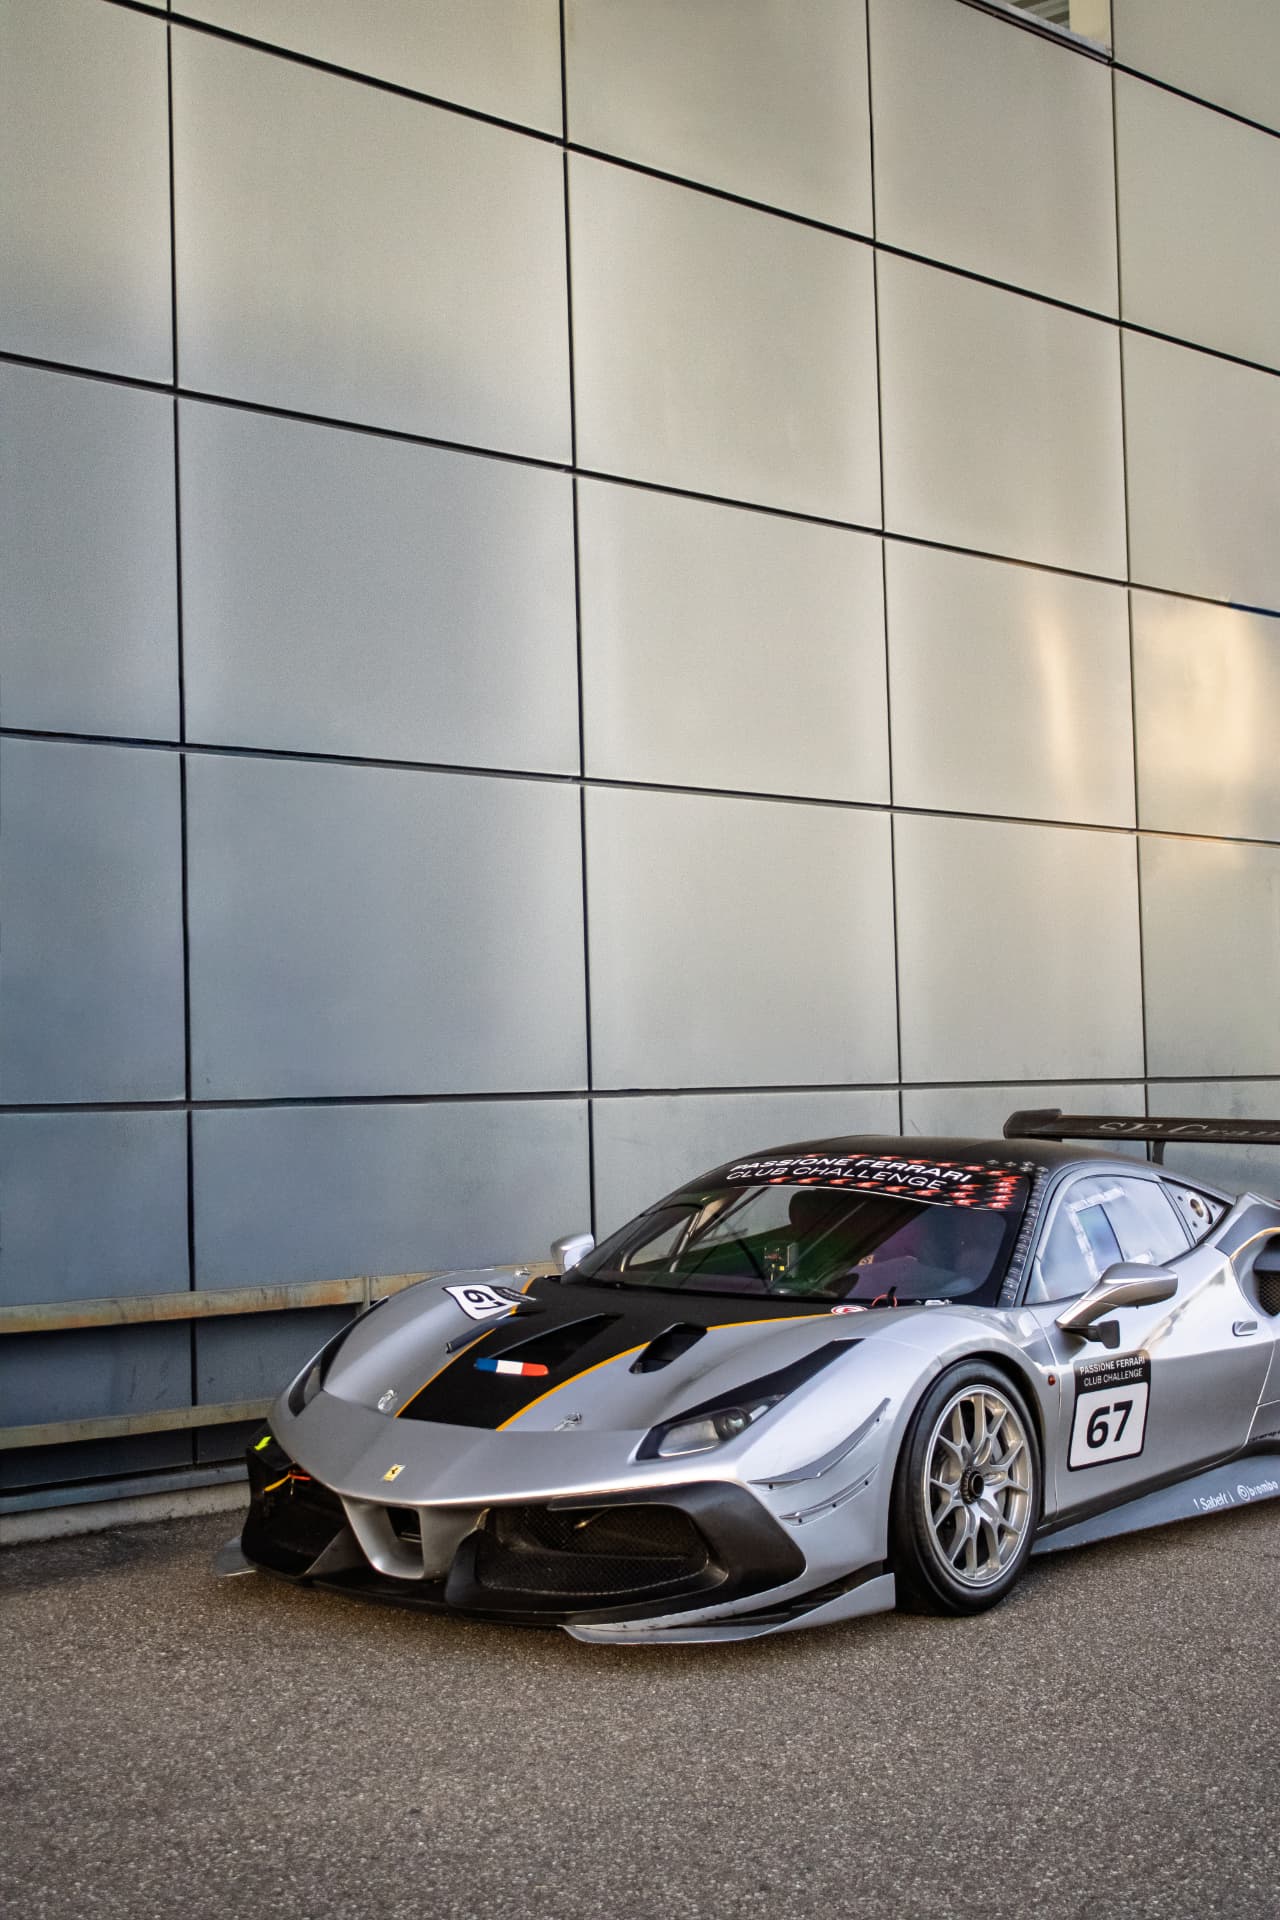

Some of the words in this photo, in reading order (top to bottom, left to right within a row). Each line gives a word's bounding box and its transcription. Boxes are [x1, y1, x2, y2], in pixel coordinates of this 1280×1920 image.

[726, 1167, 789, 1180] CLUB
[792, 1166, 947, 1190] CHALLENGE
[729, 1158, 855, 1172] PASSIONE
[855, 1159, 973, 1183] FERRARI
[1080, 1361, 1115, 1376] PASSIONE
[1115, 1356, 1146, 1369] FERRARI
[1083, 1375, 1102, 1387] CLUB
[1103, 1368, 1144, 1383] CHALLENGE
[1087, 1400, 1134, 1449] 67
[1247, 1480, 1279, 1497] brembo
